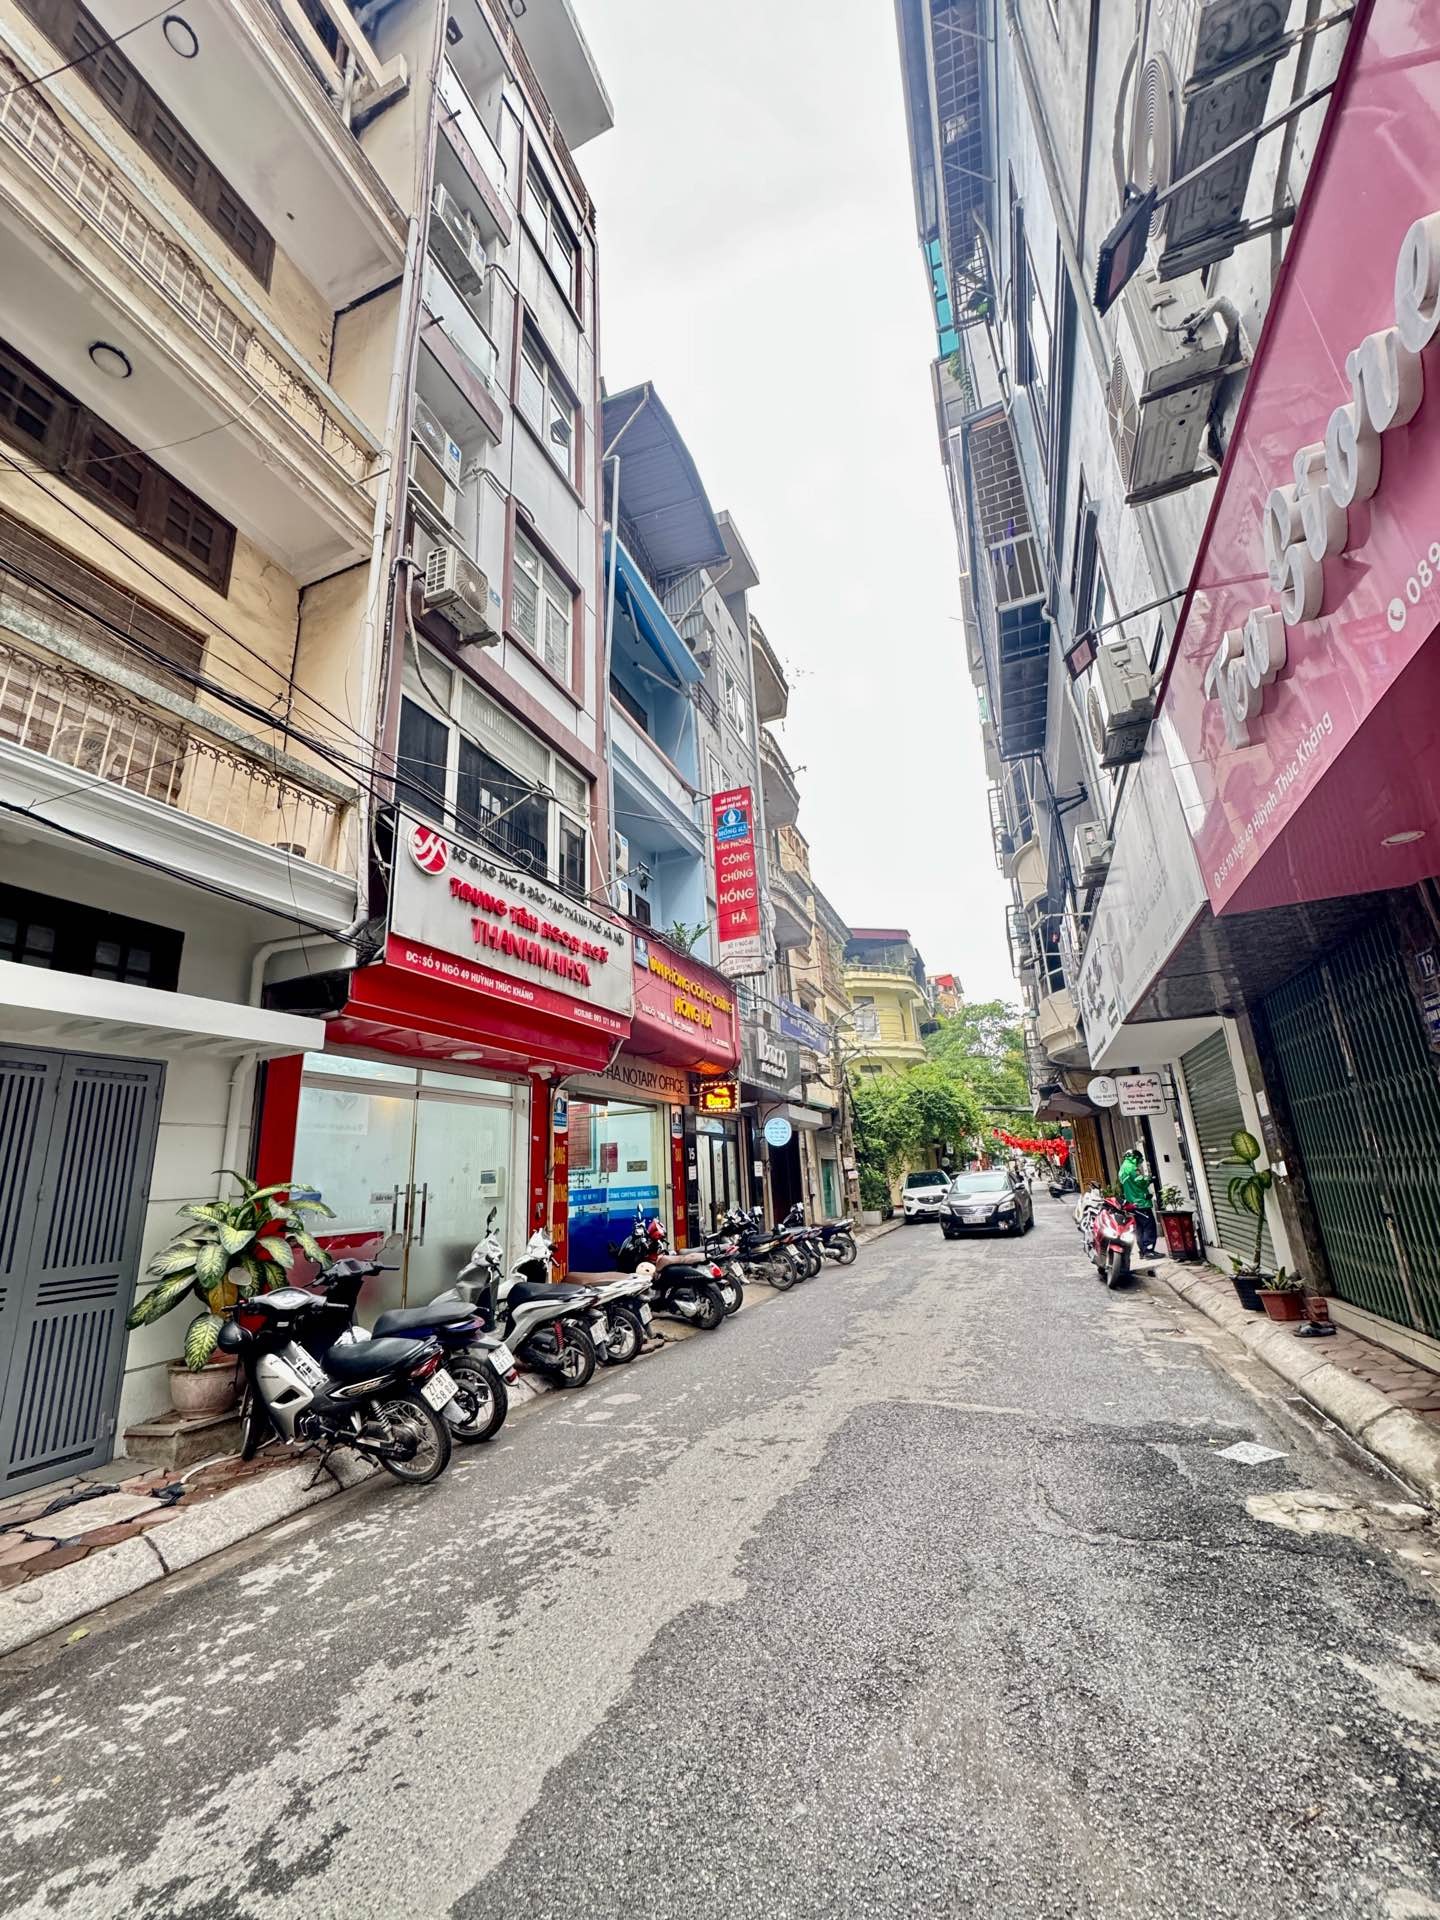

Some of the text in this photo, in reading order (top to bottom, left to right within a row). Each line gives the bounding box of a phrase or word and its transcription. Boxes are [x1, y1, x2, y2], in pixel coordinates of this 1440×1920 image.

[1264, 210, 1440, 625] Store
[1275, 760, 1299, 795] Thúc
[1296, 711, 1333, 766] Kháng
[722, 852, 750, 866] CÔNG
[519, 882, 526, 894] &
[721, 868, 754, 884] CHỨNG
[450, 877, 508, 917] TRUNG
[720, 887, 755, 905] HỒNG
[731, 909, 748, 925] HÀ
[422, 952, 434, 969] SỐ
[435, 961, 441, 971] 9
[441, 963, 460, 977] NGÕ
[460, 969, 470, 980] 49
[470, 972, 495, 989] HUỲNH
[495, 979, 512, 995] THÚC
[512, 985, 534, 1002] KHÁNG
[664, 967, 690, 992] PHÒNG
[690, 982, 712, 1003] CÔNG
[674, 992, 700, 1023] HỒNG
[700, 1009, 713, 1029] HÀ
[623, 1066, 658, 1089] NOTARY
[659, 1075, 685, 1094] OFFICE
[688, 1147, 696, 1160] 15
